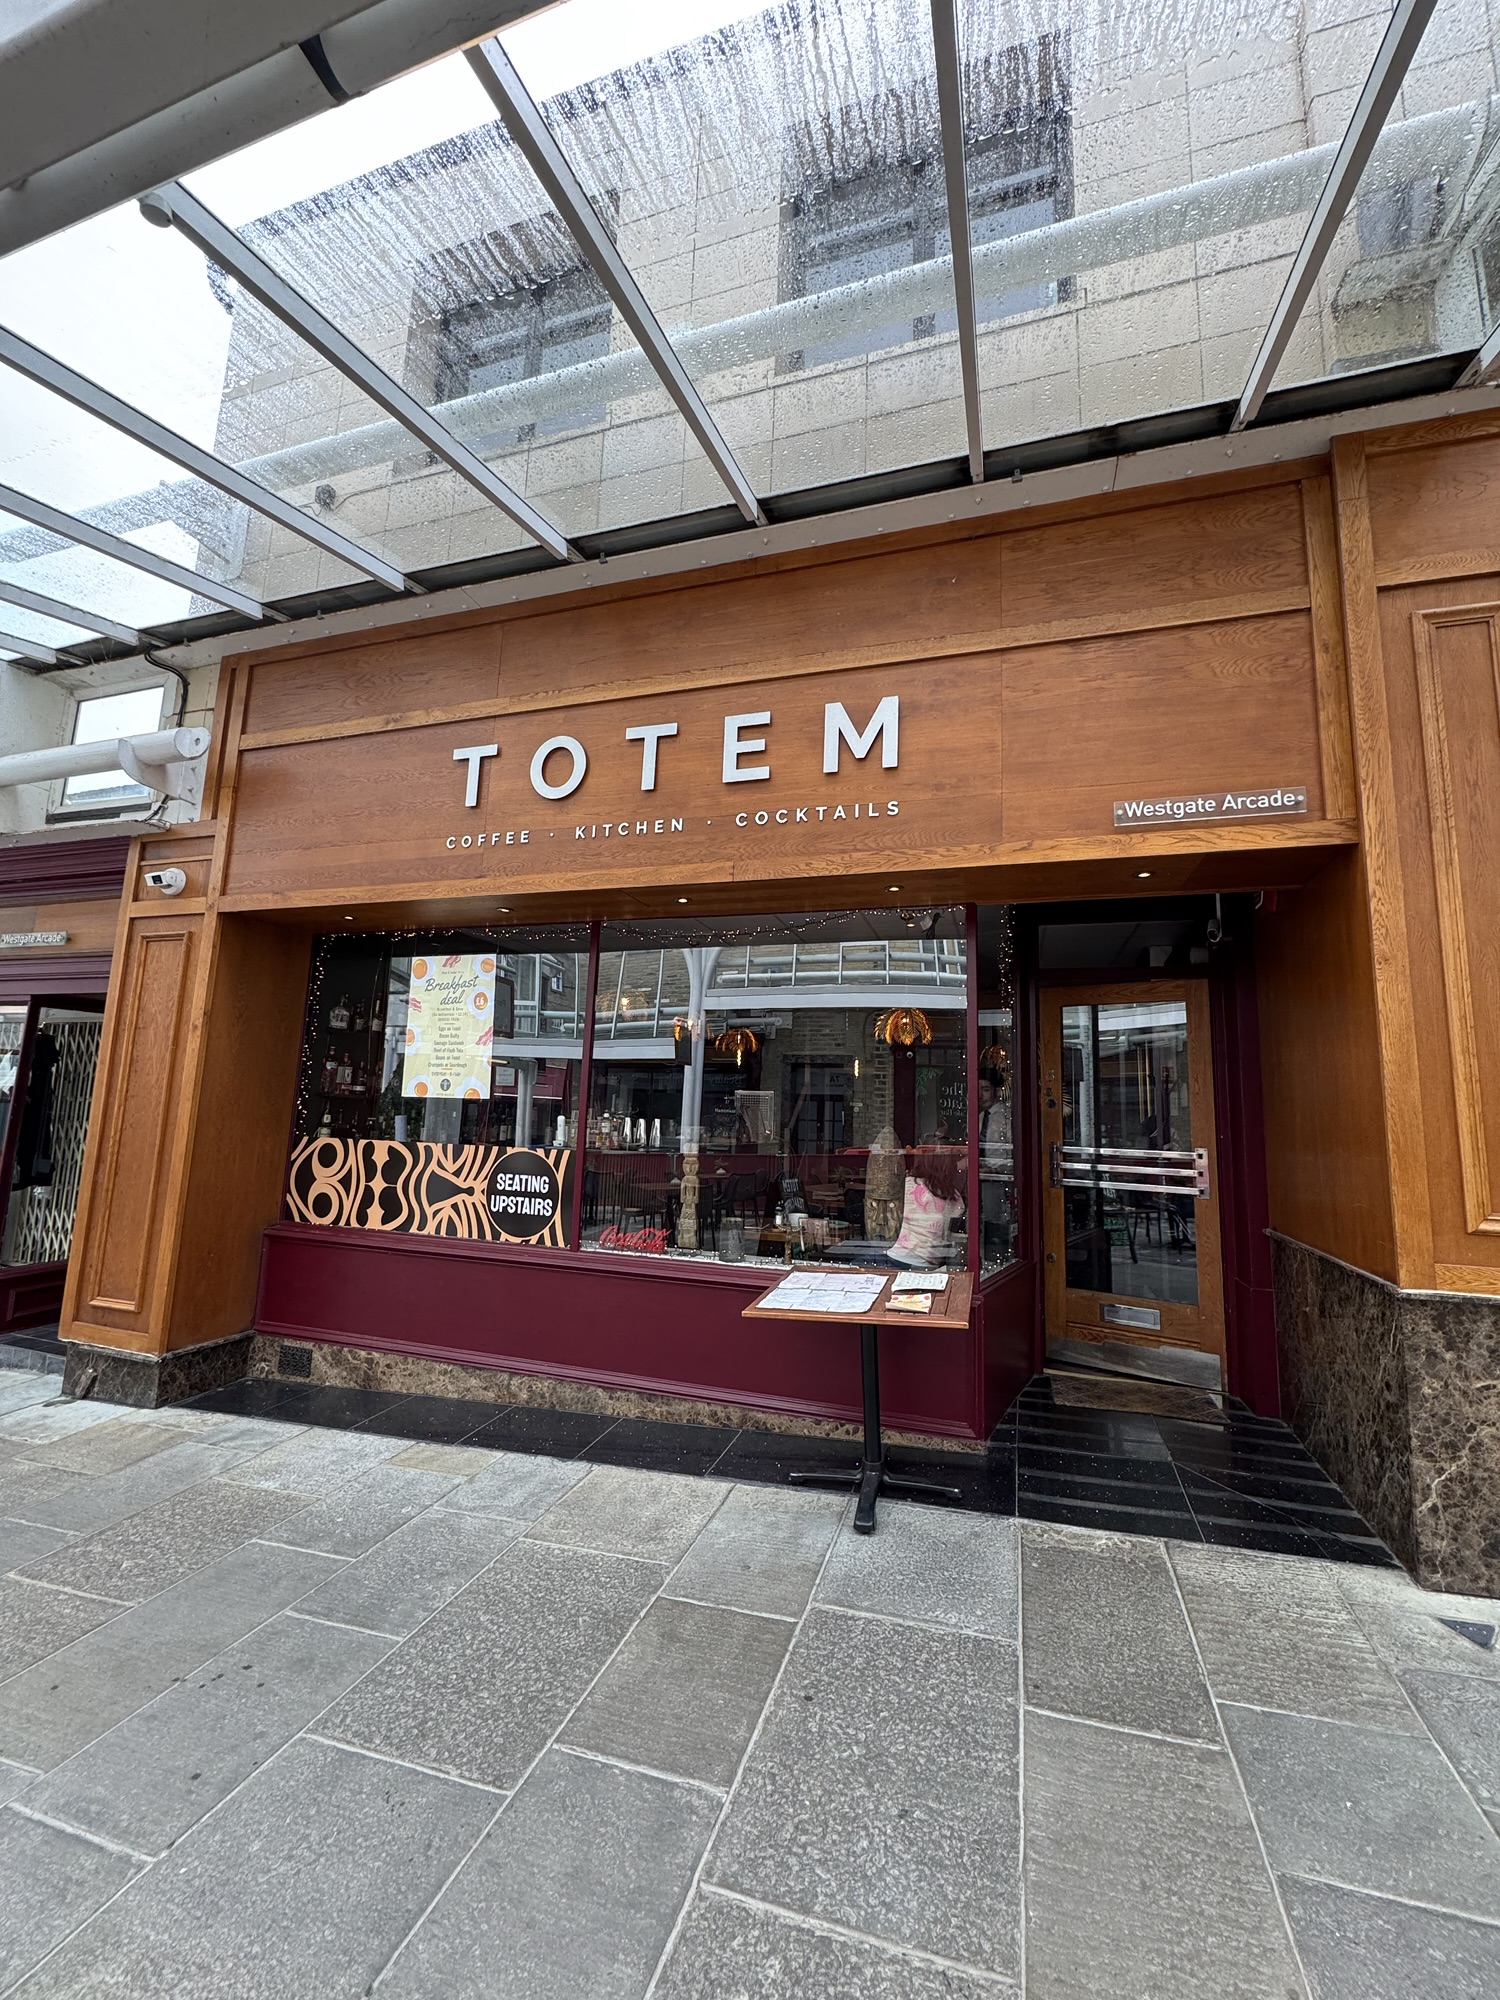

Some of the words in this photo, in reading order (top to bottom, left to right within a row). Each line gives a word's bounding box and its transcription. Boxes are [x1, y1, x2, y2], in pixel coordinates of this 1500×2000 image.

[453, 696, 900, 807] TOTEM
[1124, 797, 1216, 818] Westgate
[1222, 790, 1296, 811] Arcade
[446, 830, 531, 849] COFFEE
[575, 817, 684, 840] KITCHEN
[735, 801, 899, 827] COCKTAILS
[3, 934, 36, 946] Westgate
[36, 932, 61, 943] Arcade
[425, 974, 479, 994] Breakfast
[440, 989, 465, 1006] deal
[475, 997, 485, 1006] £6
[496, 1172, 550, 1194] SEATING
[490, 1194, 553, 1217] UPSTAIRS
